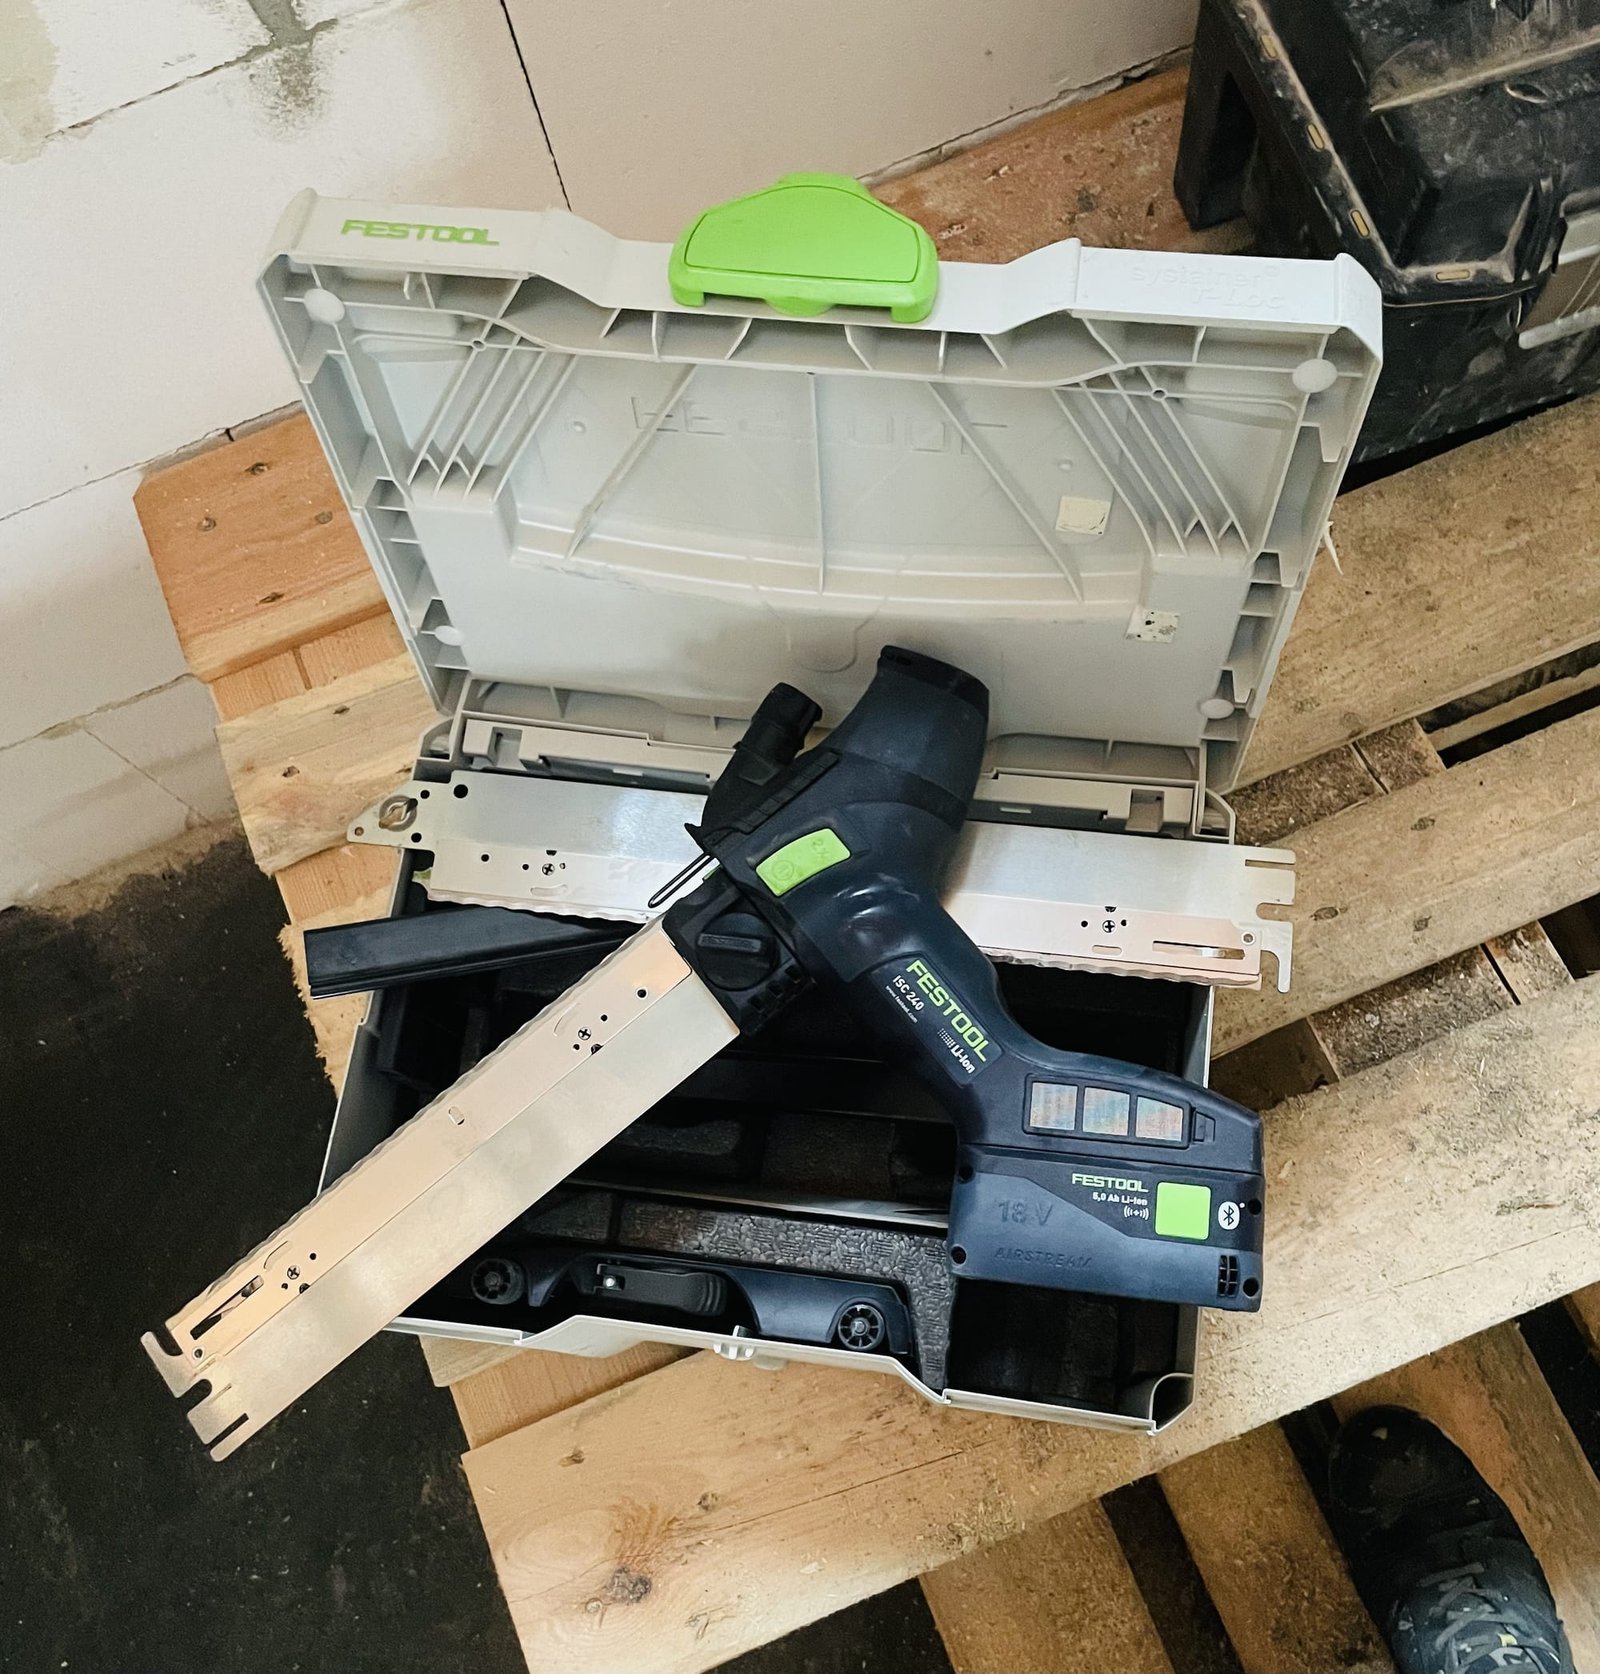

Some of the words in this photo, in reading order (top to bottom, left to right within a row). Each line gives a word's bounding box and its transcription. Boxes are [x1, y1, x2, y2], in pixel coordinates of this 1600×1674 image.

[340, 218, 500, 247] FESTOOL
[892, 974, 910, 993] ISC
[905, 991, 925, 1011] 240
[905, 959, 989, 1063] FESTOOL
[950, 1044, 976, 1074] Li-Ion
[1071, 1172, 1149, 1193] FESTOOL
[1092, 1191, 1107, 1202] 5,0
[1107, 1193, 1120, 1203] Ah
[998, 1200, 1027, 1223] 18
[1035, 1201, 1053, 1226] V
